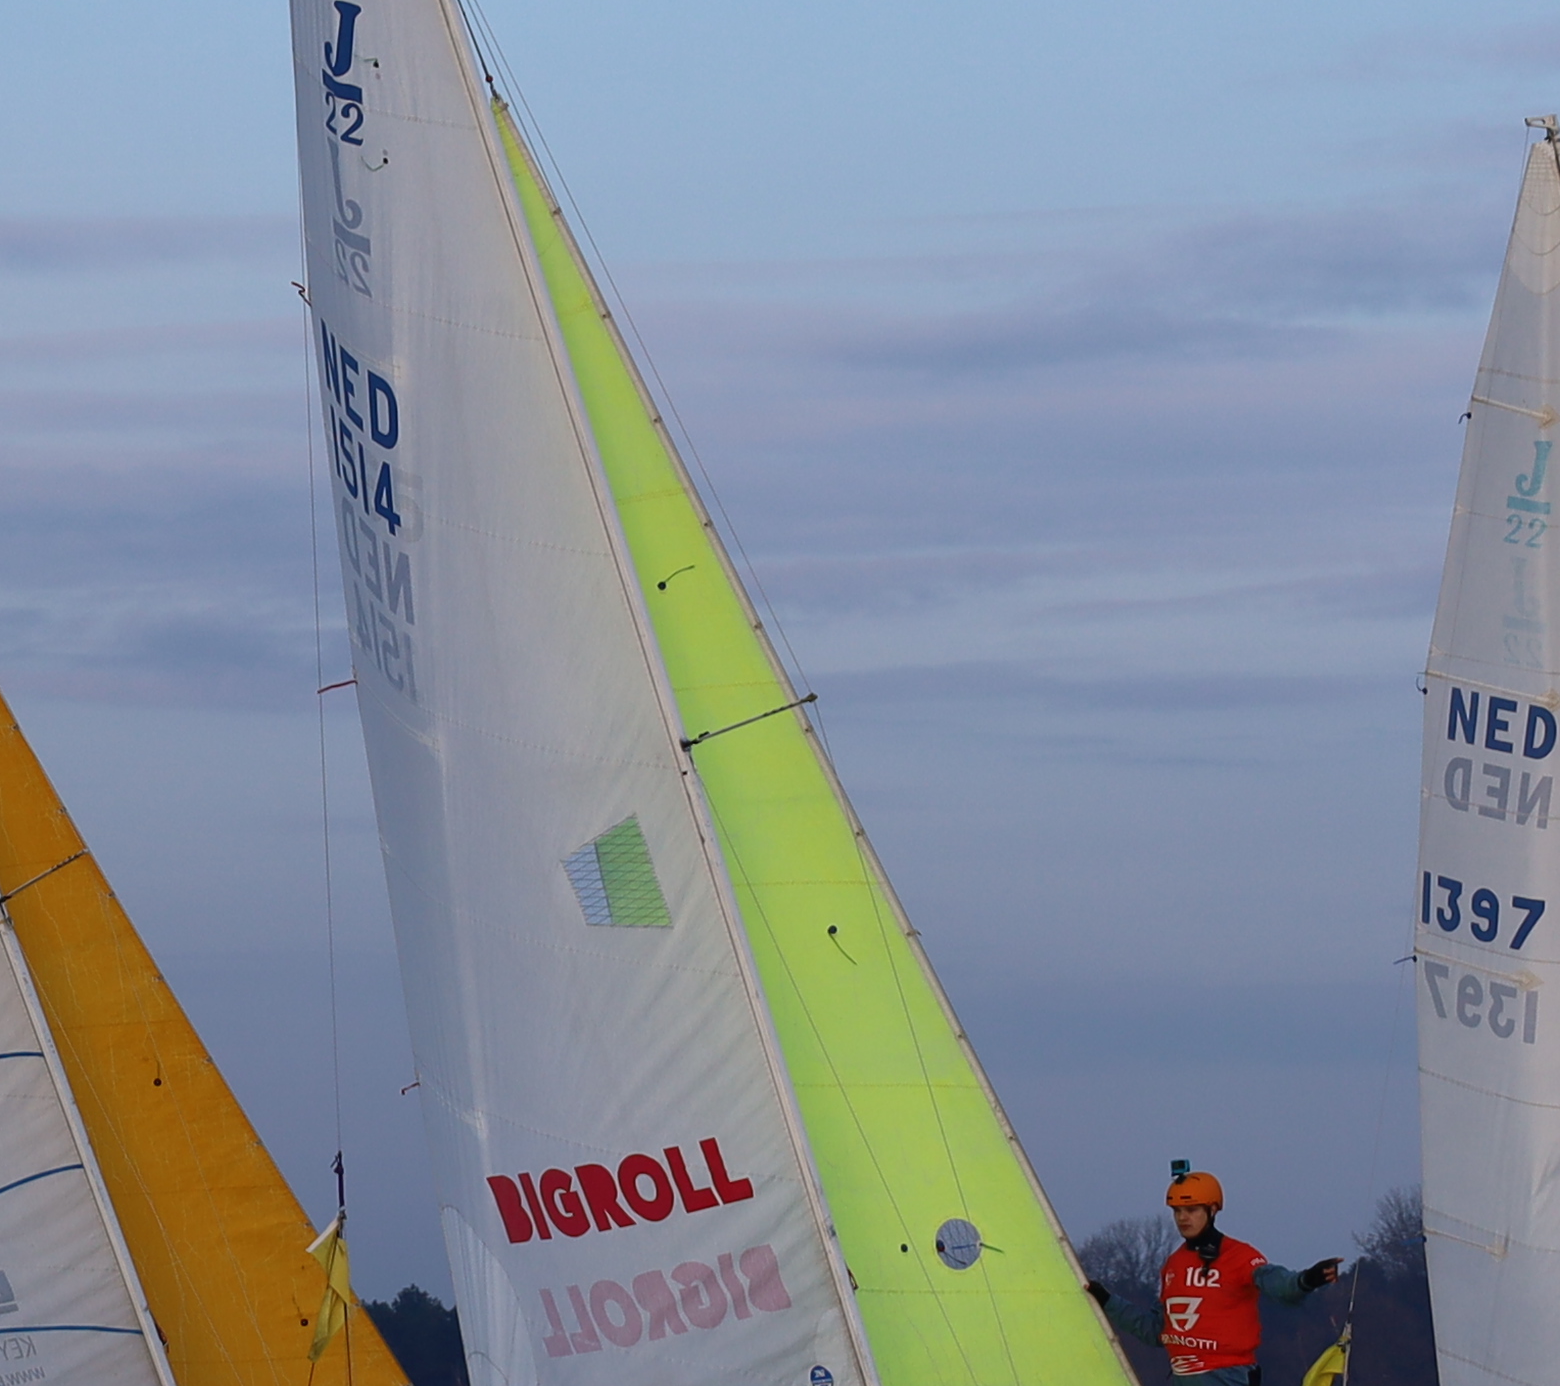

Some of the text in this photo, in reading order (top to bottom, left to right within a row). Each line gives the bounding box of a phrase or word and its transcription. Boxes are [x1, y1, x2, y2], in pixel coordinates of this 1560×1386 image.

[325, 91, 364, 146] 22
[320, 317, 399, 450] NED
[330, 403, 401, 537] 1514
[1504, 516, 1549, 549] 22
[1446, 687, 1558, 760] NED
[1421, 871, 1546, 951] 1397
[486, 1136, 755, 1244] BIGROLL
